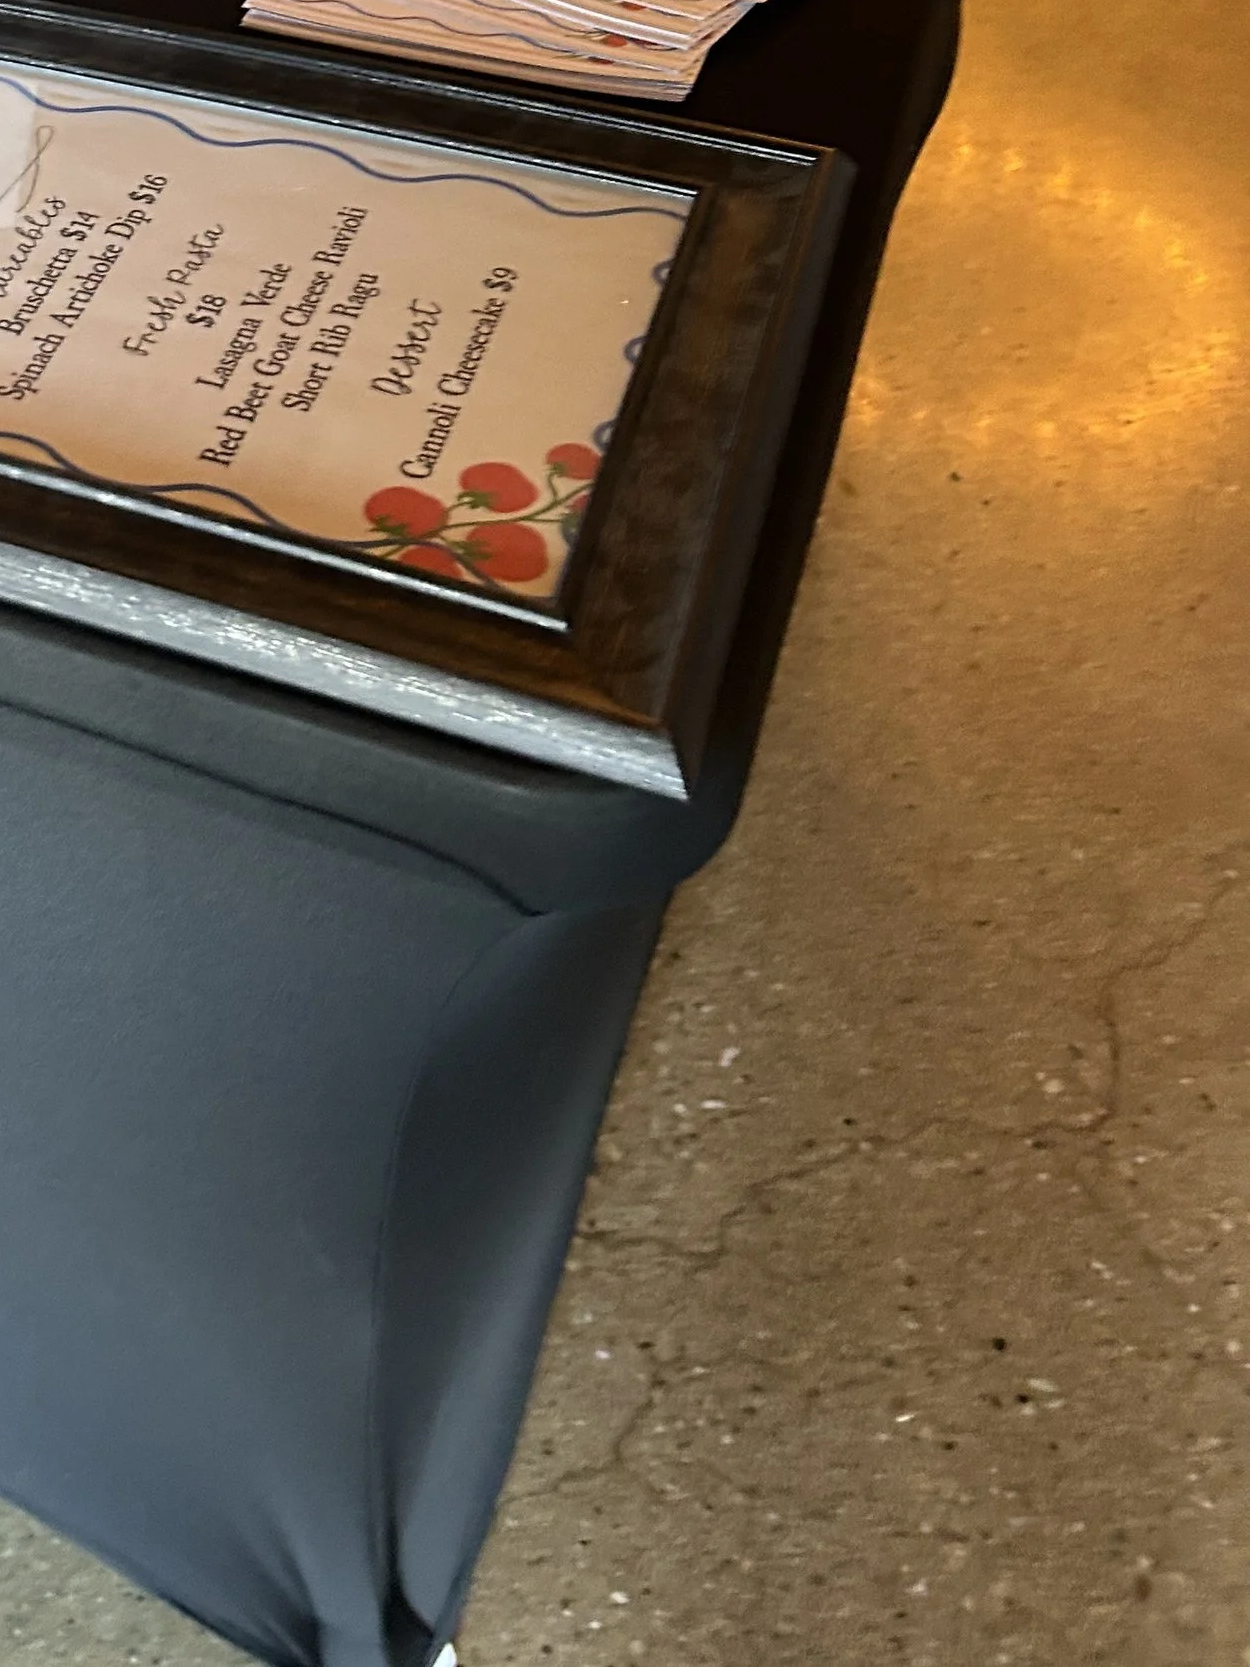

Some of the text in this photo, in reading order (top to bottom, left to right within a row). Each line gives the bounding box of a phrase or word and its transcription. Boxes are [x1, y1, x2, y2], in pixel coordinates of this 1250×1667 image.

[59, 210, 102, 242] $14
[104, 208, 154, 241] Dip
[127, 173, 169, 205] $16
[49, 243, 125, 329] Artichoke
[121, 222, 225, 357] Fresh Pasta
[185, 293, 229, 328] $18
[195, 262, 293, 390] Lasagna Verde
[197, 204, 368, 468] Red Beet Goat Cheese Ravioli
[280, 272, 382, 412] Short Rib Ragu
[368, 297, 443, 397] Dessert
[399, 266, 519, 479] Cannoli Cheesecake $9
